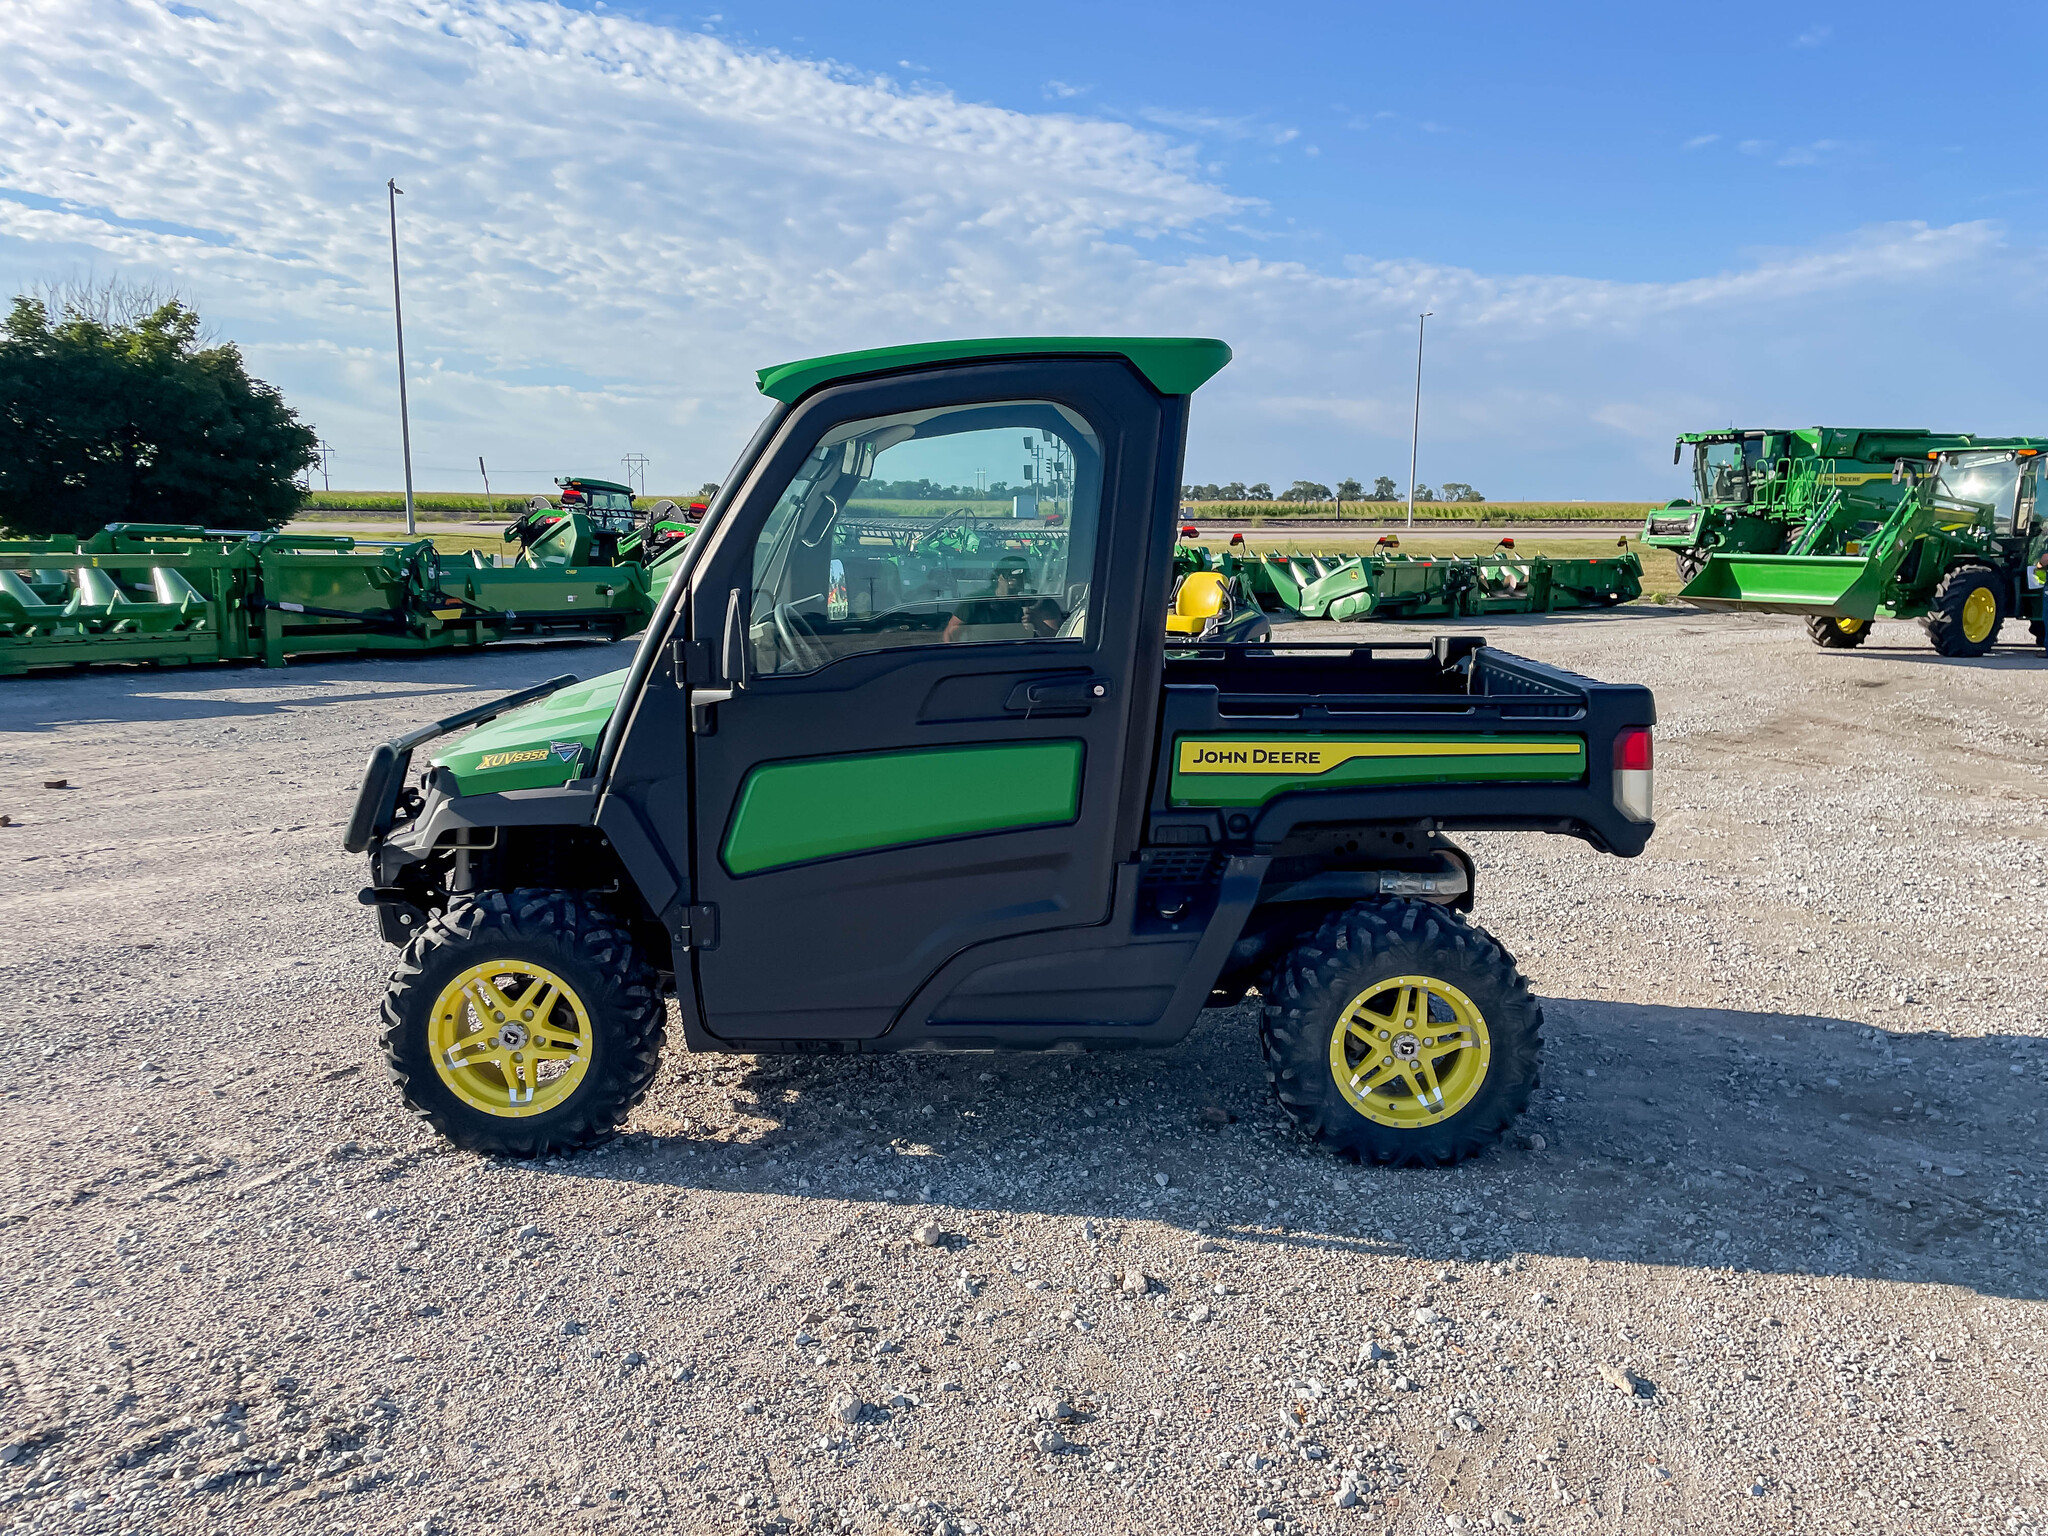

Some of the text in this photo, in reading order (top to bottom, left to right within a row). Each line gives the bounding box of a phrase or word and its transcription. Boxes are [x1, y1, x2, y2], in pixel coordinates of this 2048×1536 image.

[475, 749, 549, 770] XUV835R
[1193, 749, 1320, 764] JOHN DEERE
